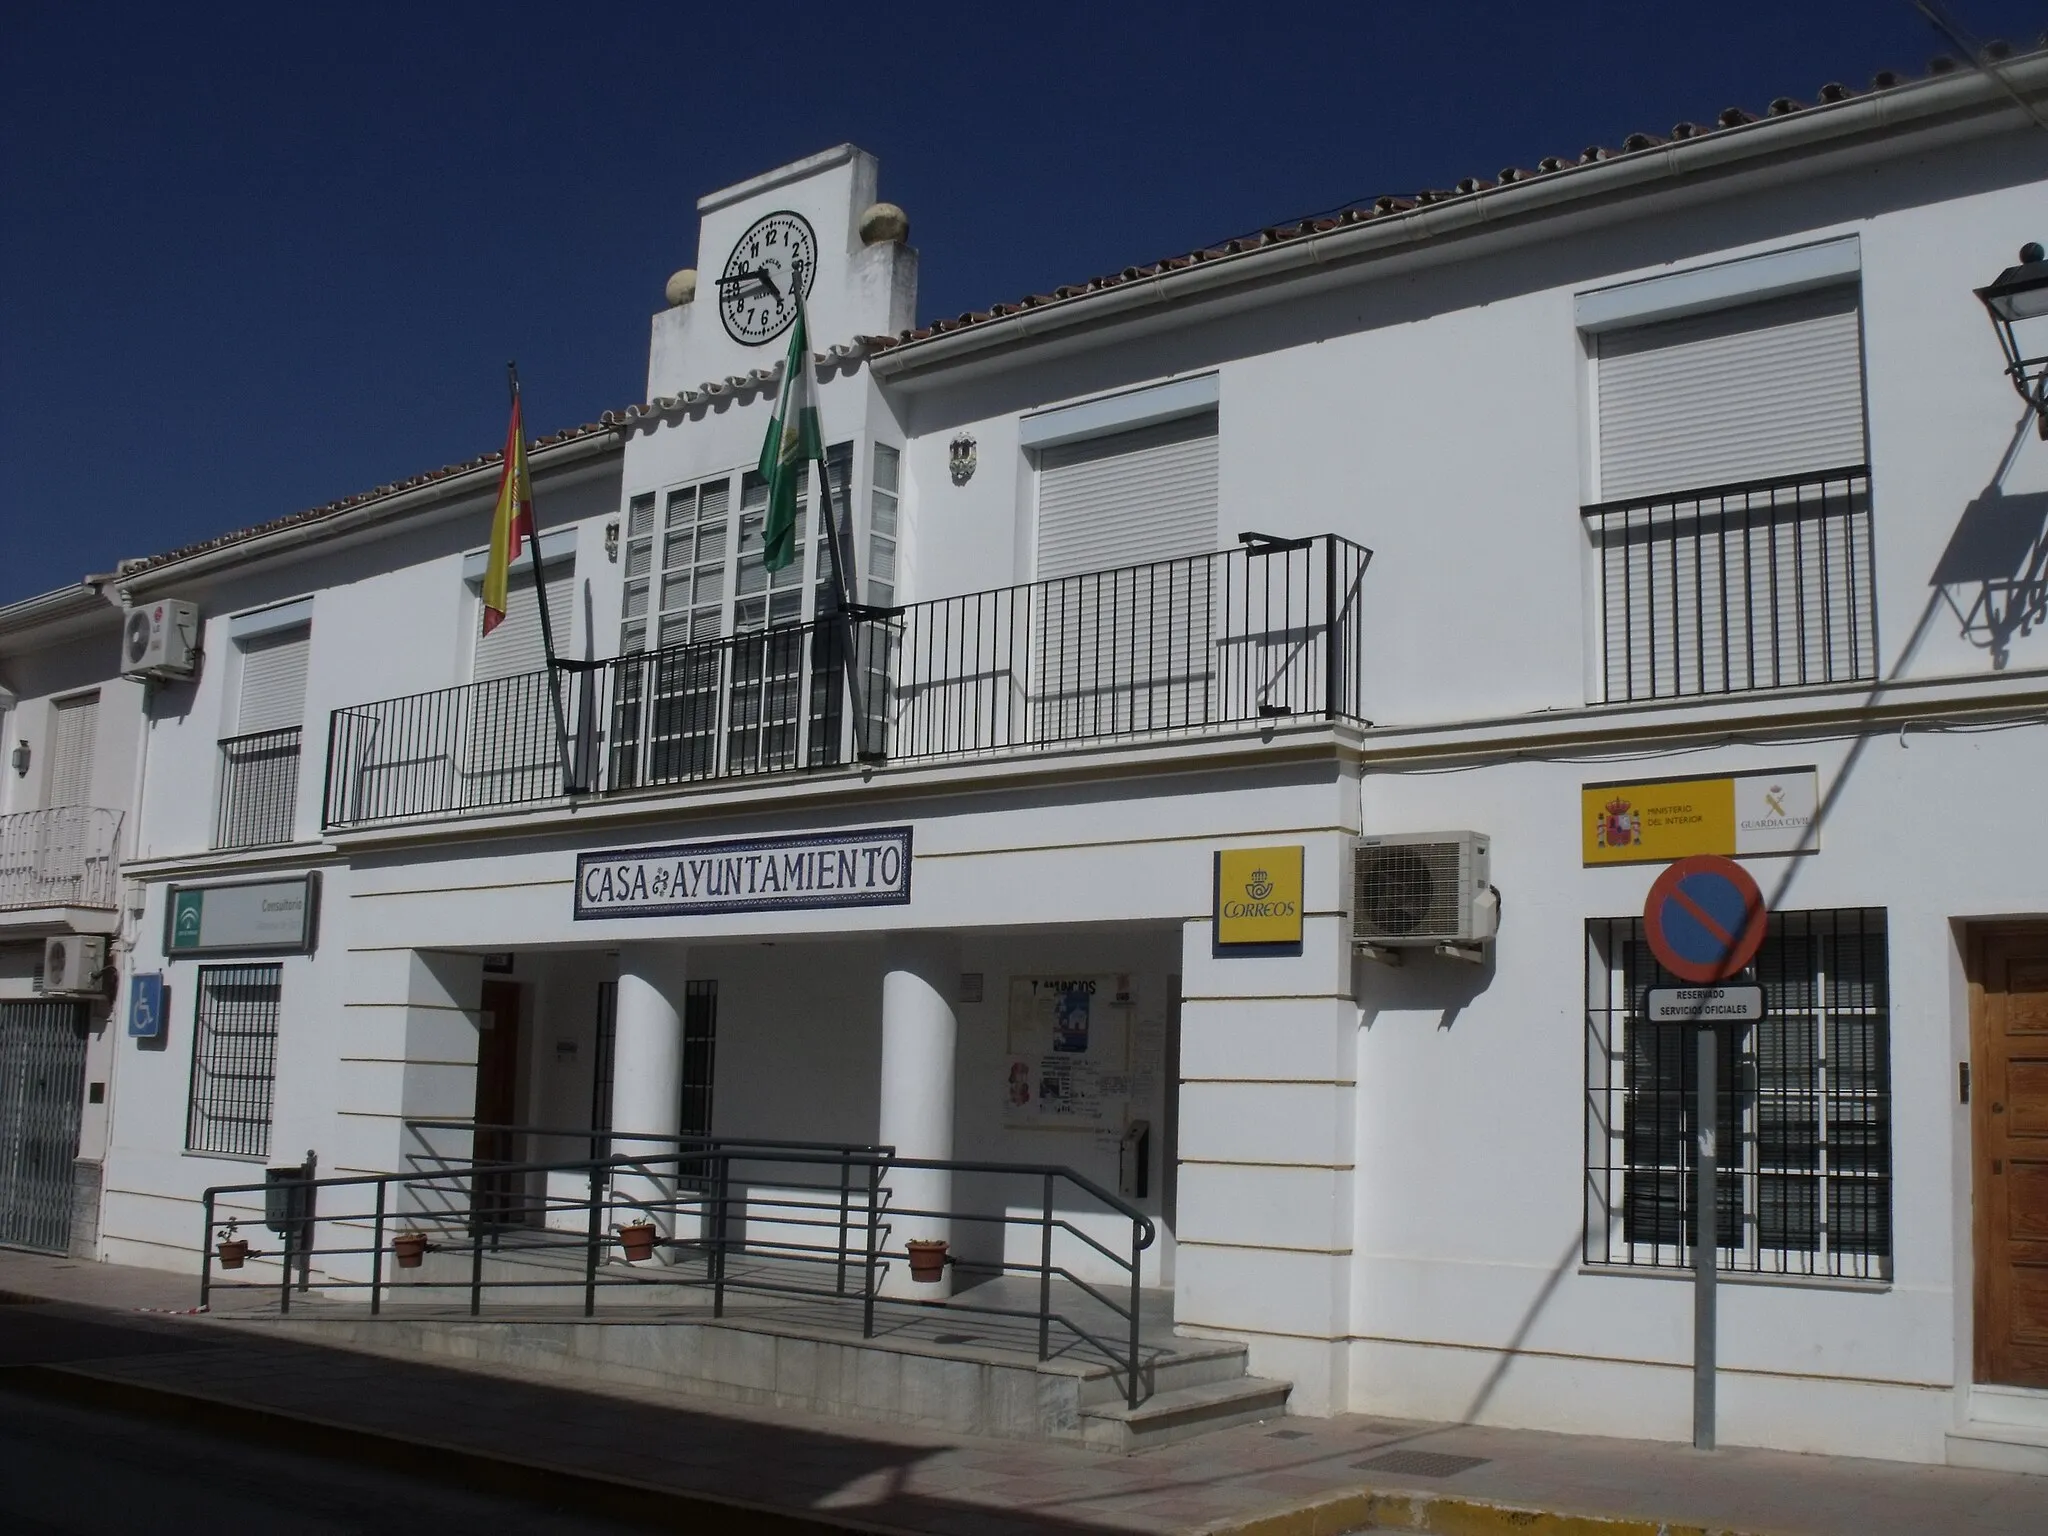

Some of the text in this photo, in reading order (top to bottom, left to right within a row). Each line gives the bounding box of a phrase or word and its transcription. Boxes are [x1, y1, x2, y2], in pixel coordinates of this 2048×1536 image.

[766, 229, 777, 246] 12
[783, 231, 789, 247] 1
[750, 241, 760, 258] 11
[792, 242, 800, 258] 2
[736, 298, 744, 313] 8
[747, 308, 755, 325] 7
[761, 309, 769, 325] 6
[1647, 805, 1693, 815] MINISTERIO
[1648, 815, 1703, 826] DEL INTERIOR
[1741, 816, 1811, 829] GUARDIA CIVIL
[585, 845, 901, 903] CASA AYUNTAMIENTO
[262, 897, 303, 913] Consultorio
[1223, 900, 1295, 919] CORREOS
[1676, 989, 1725, 1000] RESERVADO
[1660, 1003, 1748, 1016] SERVICIOS OFICIALES
